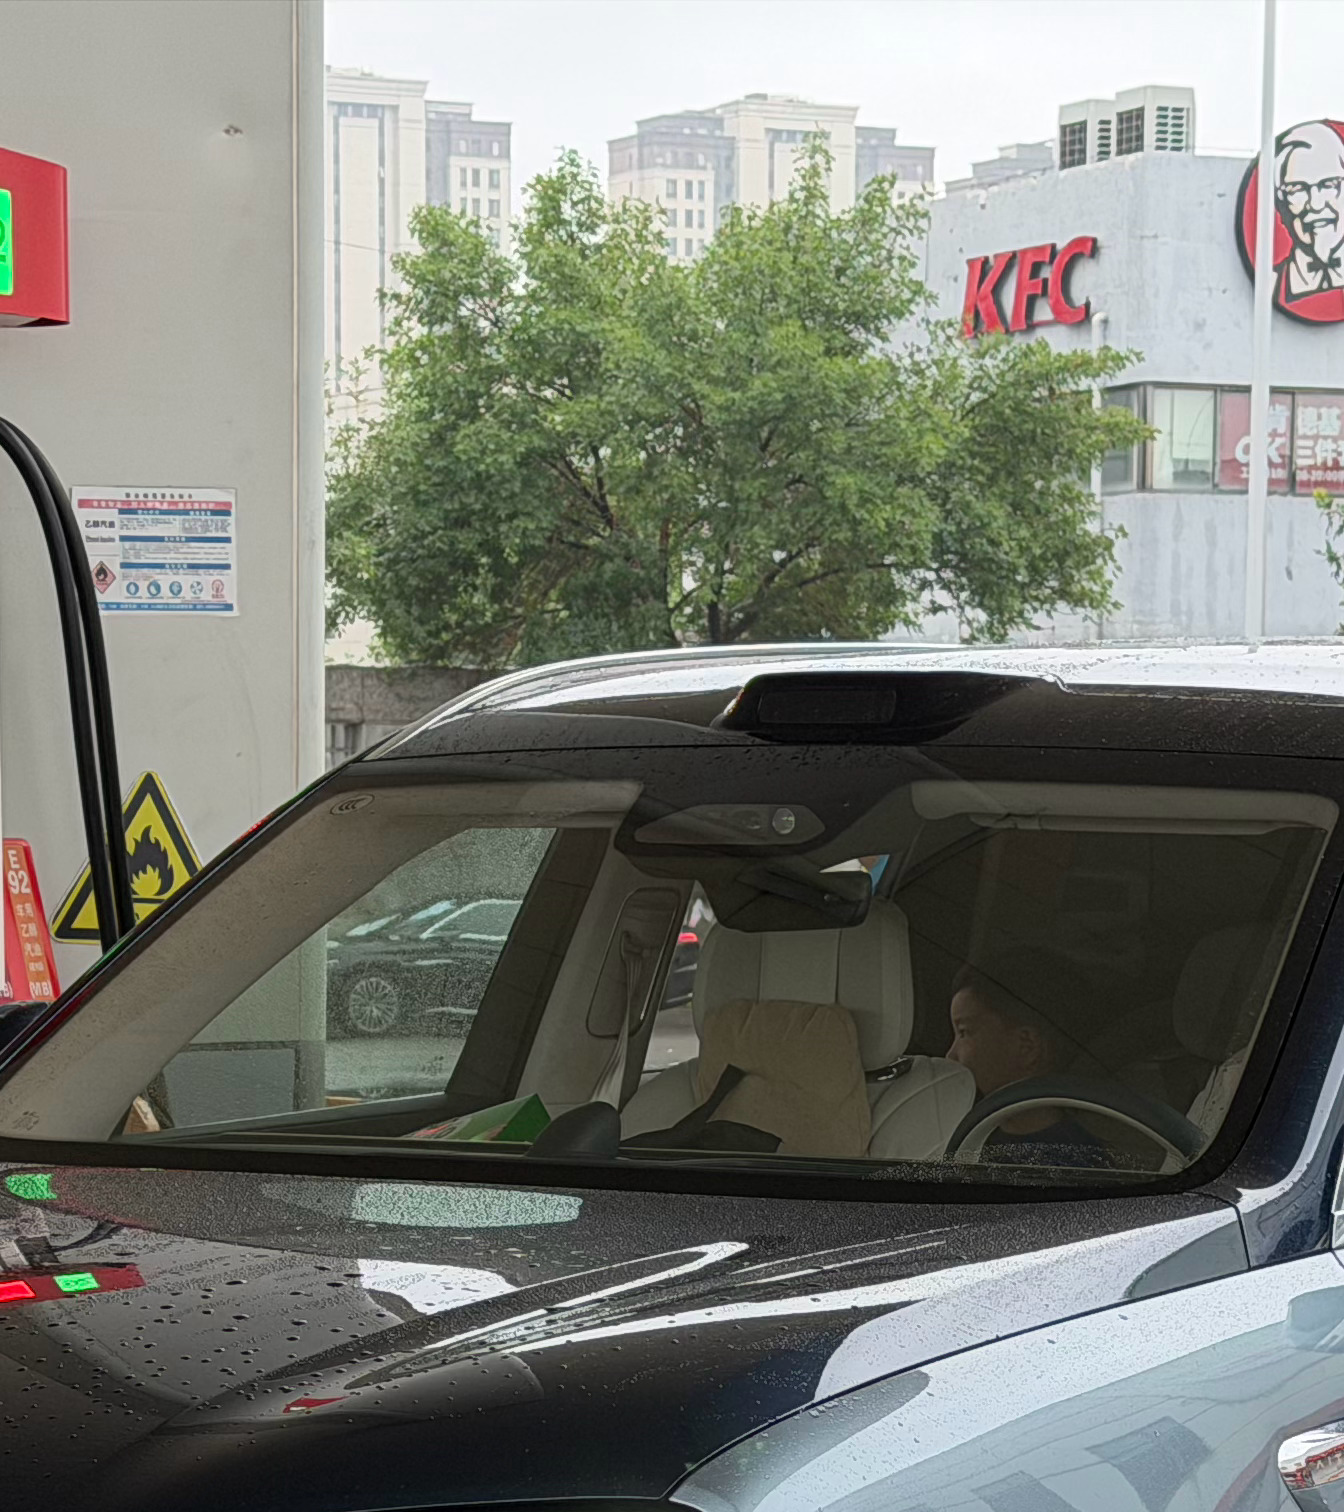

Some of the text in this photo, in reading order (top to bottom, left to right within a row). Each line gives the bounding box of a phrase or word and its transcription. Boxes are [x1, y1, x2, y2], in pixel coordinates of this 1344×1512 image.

[961, 235, 1096, 338] KFC
[7, 849, 21, 869] E
[7, 870, 31, 894] 92
